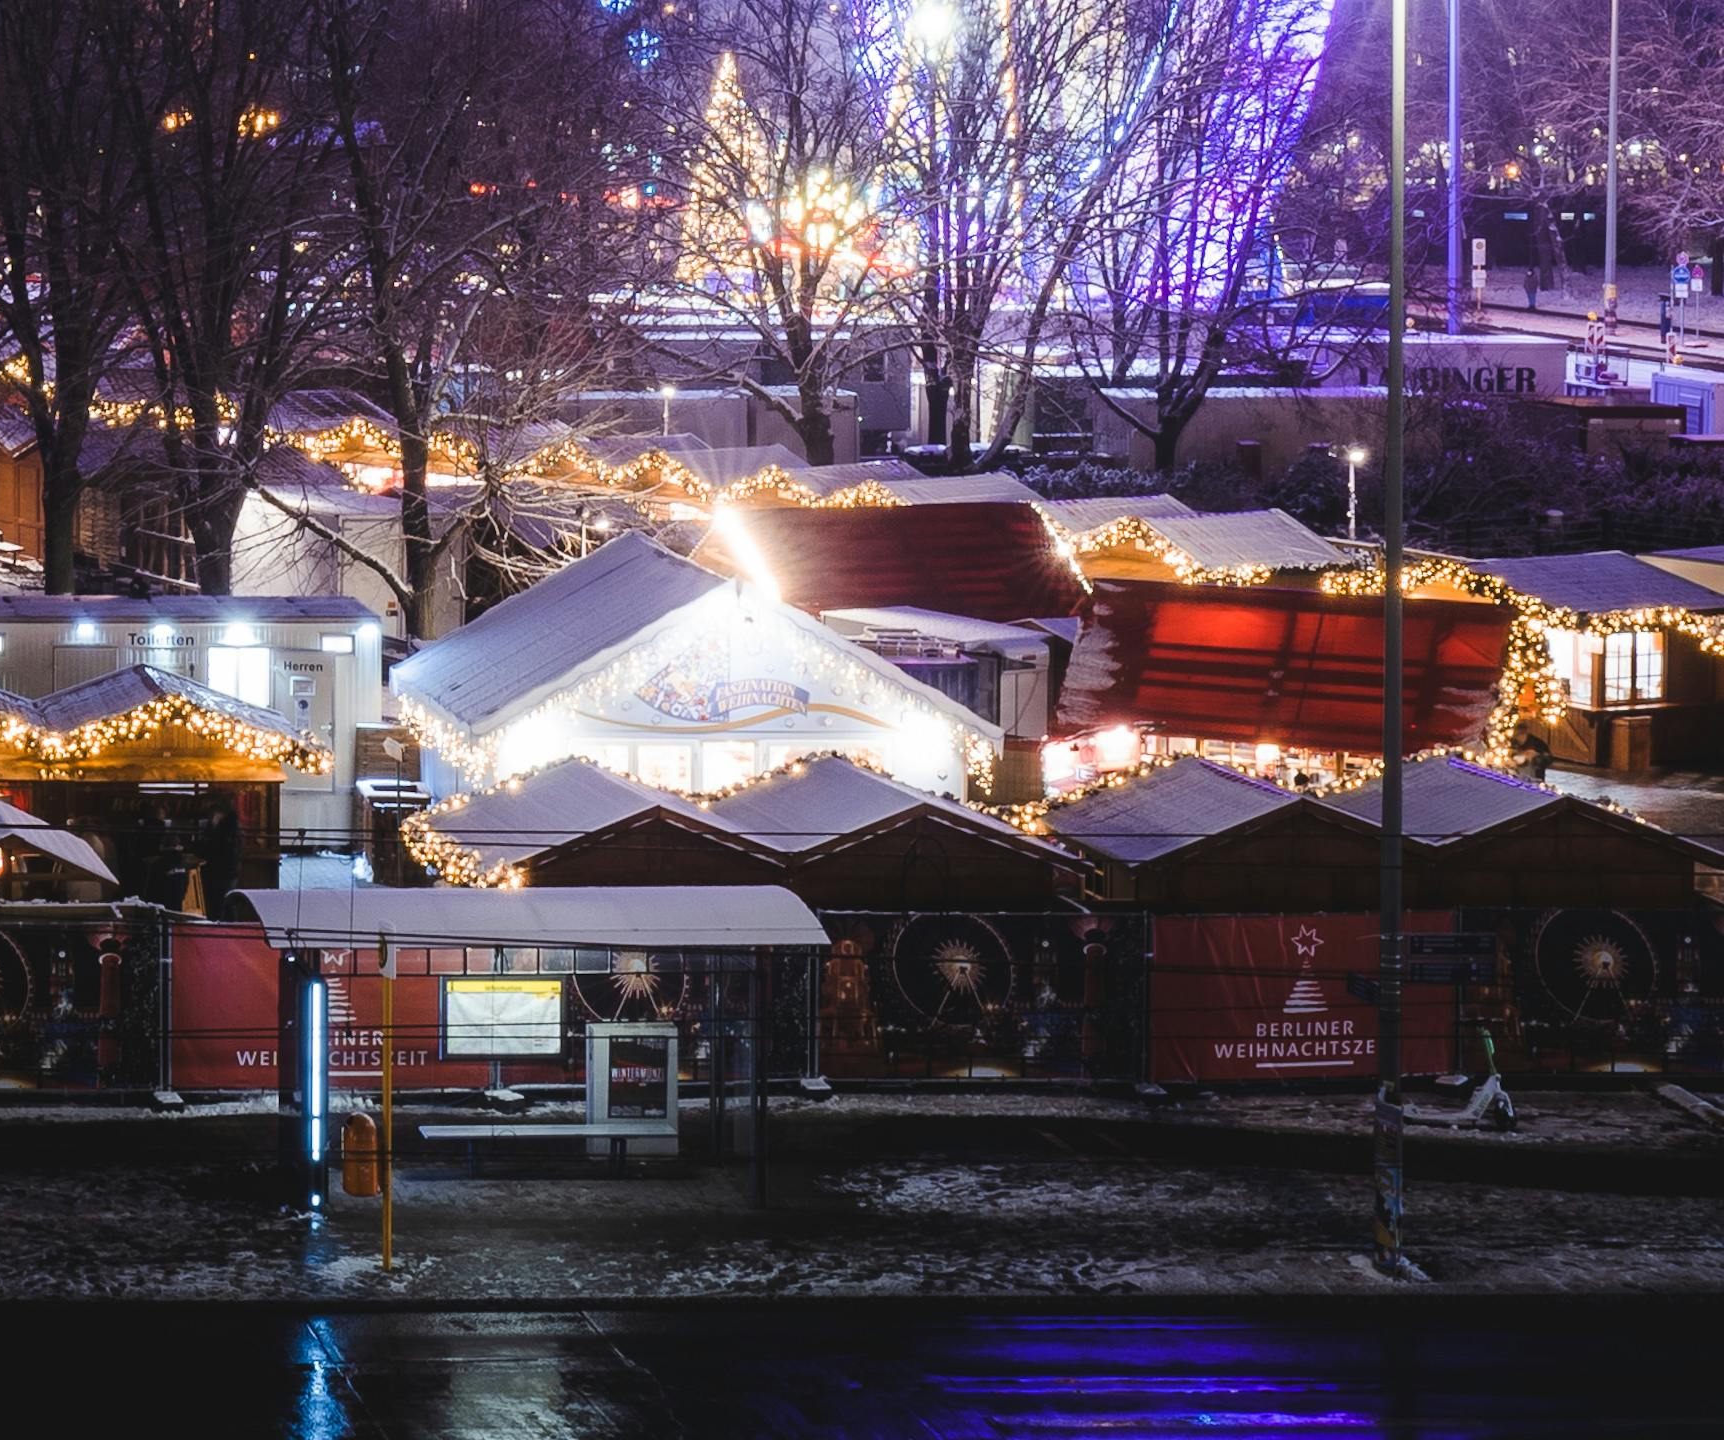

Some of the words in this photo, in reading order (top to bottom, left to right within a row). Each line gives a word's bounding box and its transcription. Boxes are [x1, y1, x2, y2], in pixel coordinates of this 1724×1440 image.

[283, 661, 323, 672] Herren
[716, 680, 795, 702] FASZINATION
[718, 692, 807, 714] WEIHNACHTEN
[1253, 1020, 1354, 1037] BERLINER
[236, 1050, 428, 1066] WEICHTSEIT
[1214, 1039, 1375, 1059] WEIHNACHTSZE
